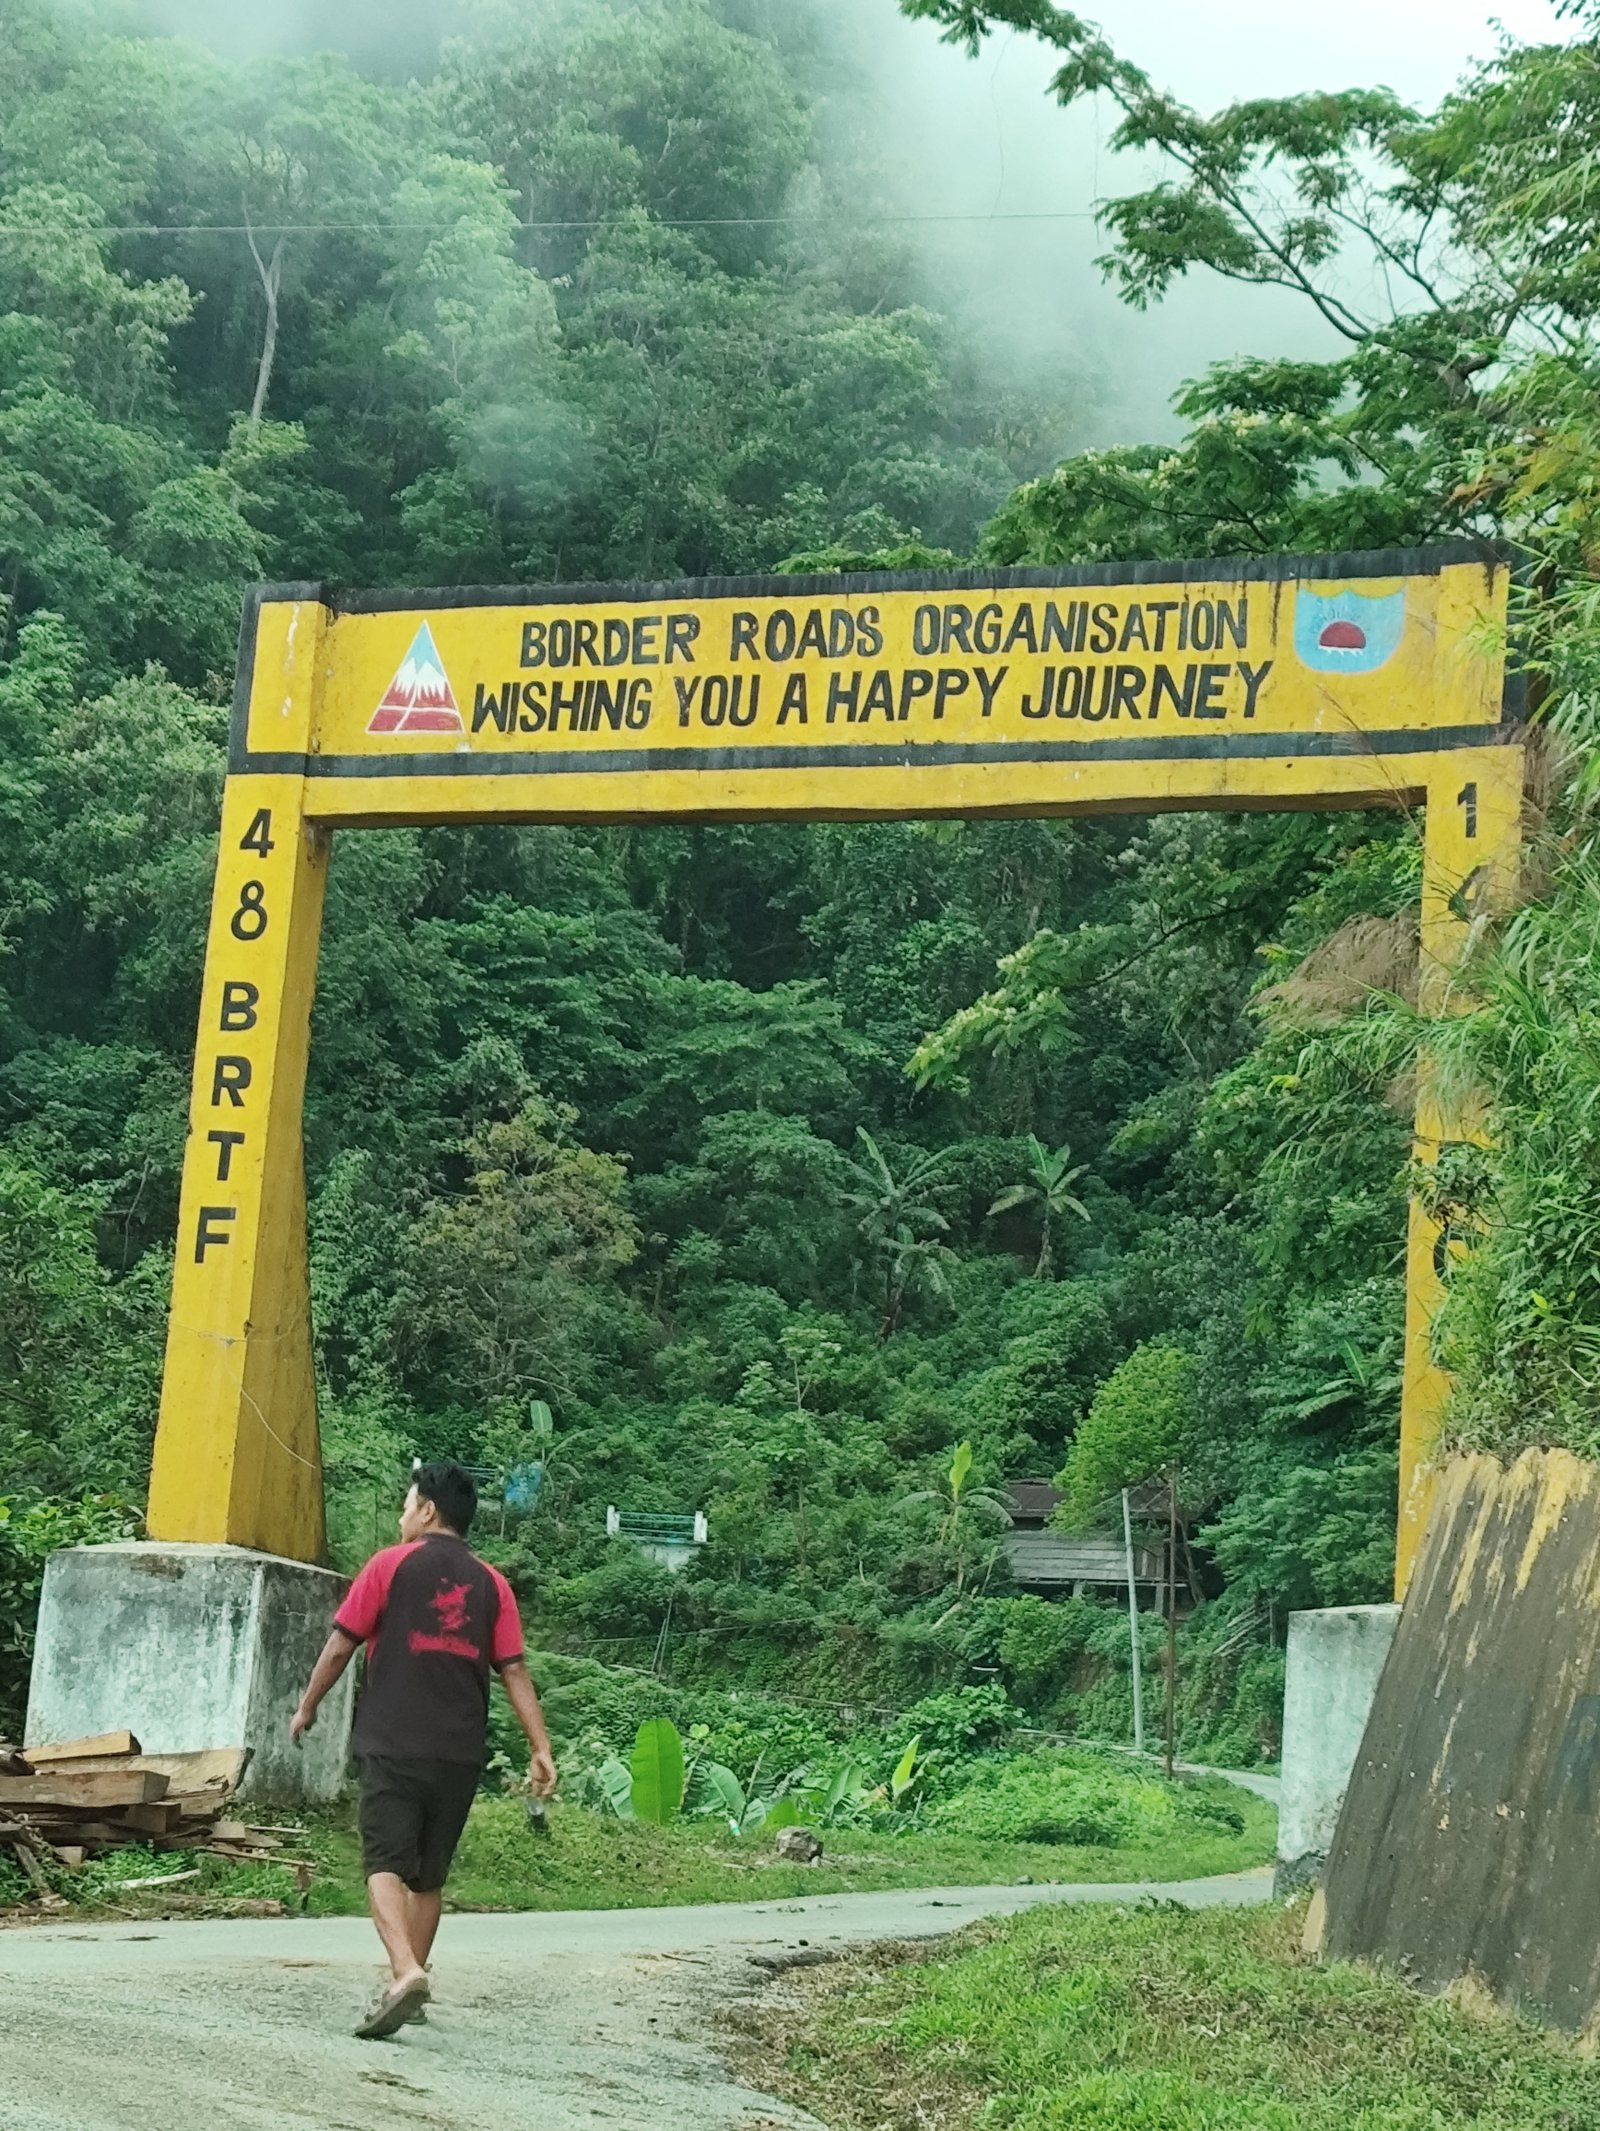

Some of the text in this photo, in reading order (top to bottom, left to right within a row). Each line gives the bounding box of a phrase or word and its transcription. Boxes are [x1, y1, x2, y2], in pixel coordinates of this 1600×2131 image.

[519, 598, 1249, 668] BORDER ROADS ORGANISATION
[471, 659, 1274, 735] WISHING YOU A HAPPY JOURNEY
[193, 808, 275, 1265] 48 BRTF
